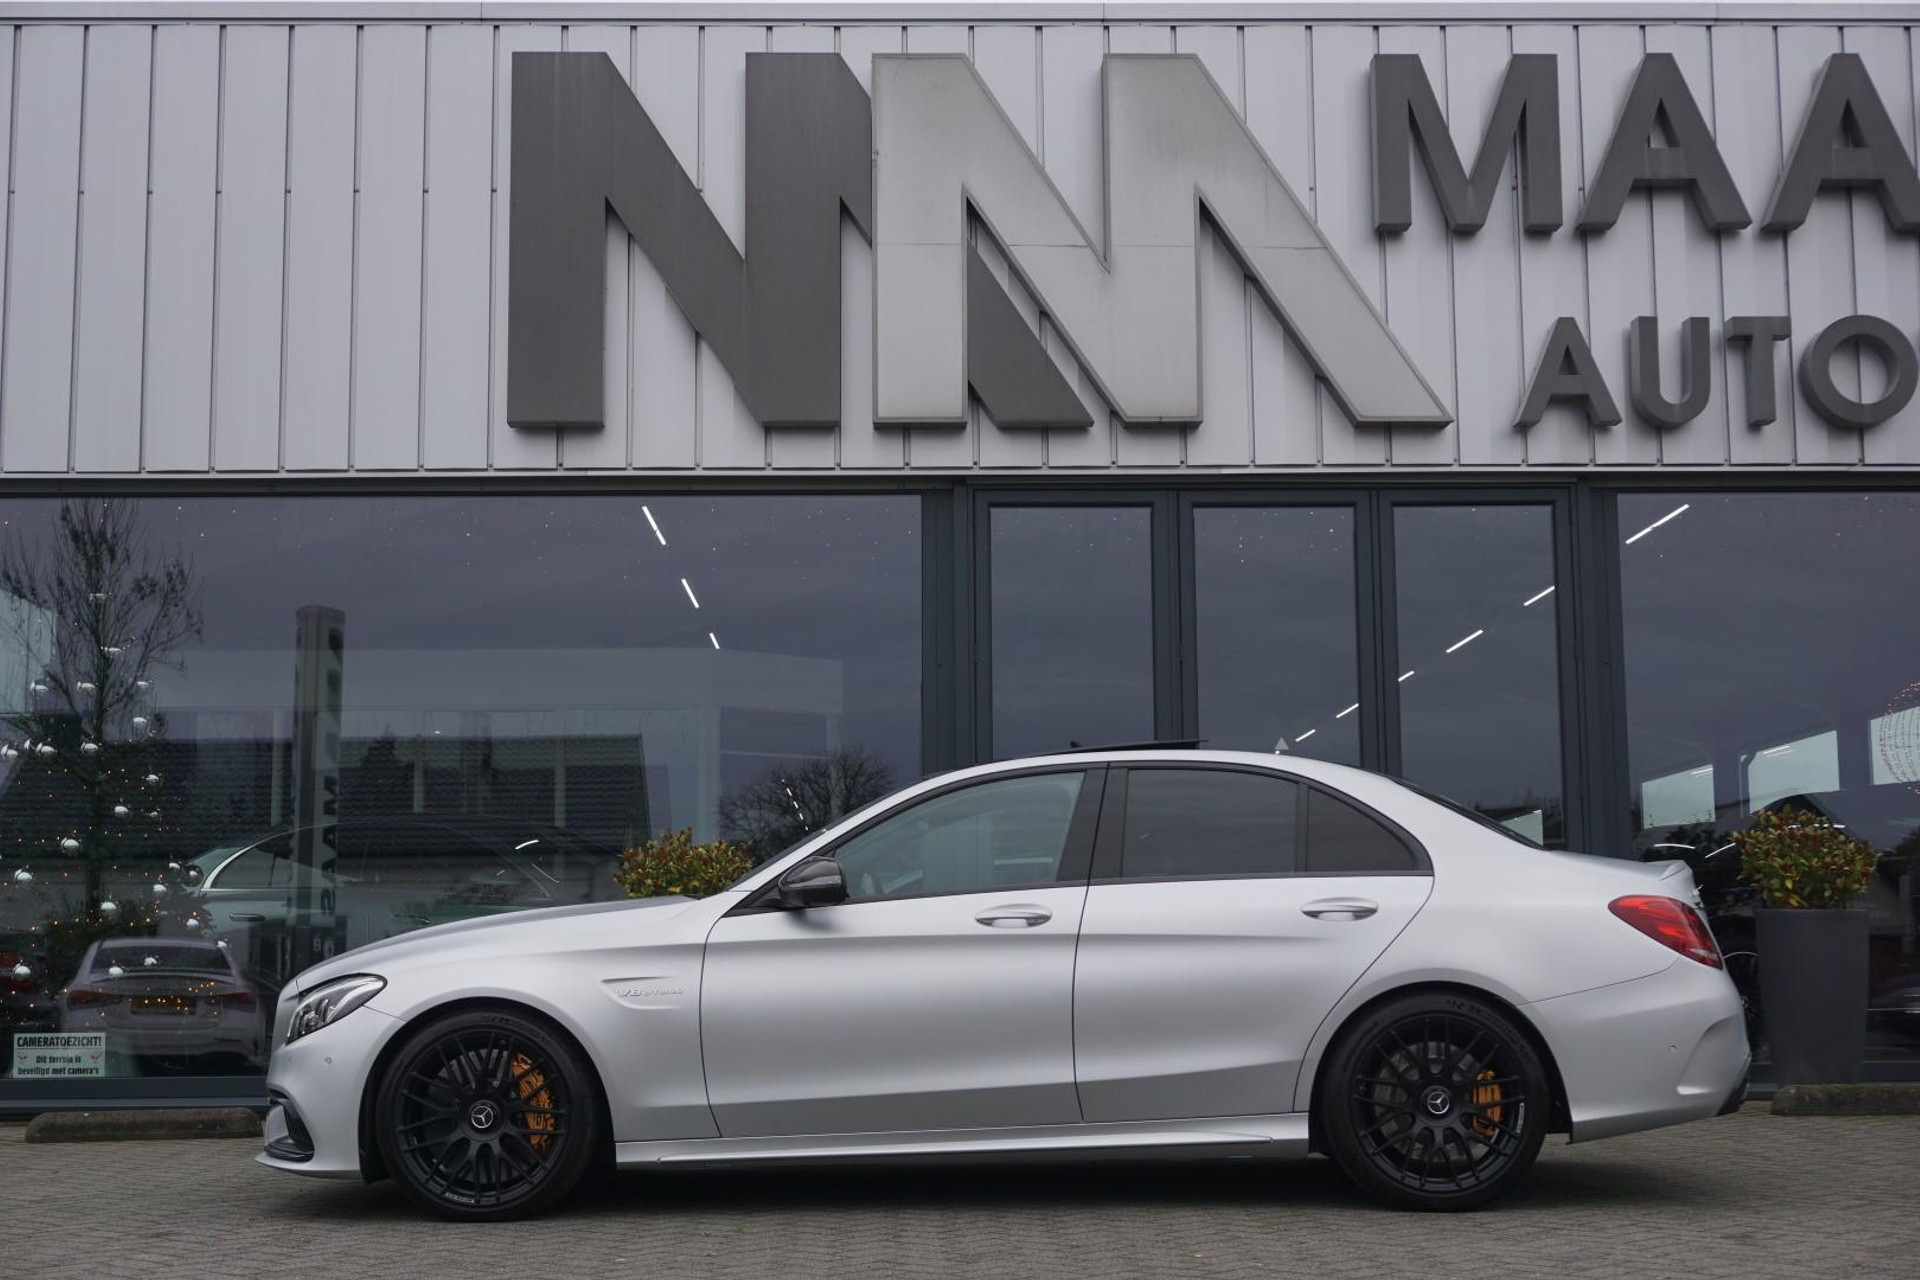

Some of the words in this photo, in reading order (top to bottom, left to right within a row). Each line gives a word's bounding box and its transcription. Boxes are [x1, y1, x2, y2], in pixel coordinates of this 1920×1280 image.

[1514, 314, 1919, 429] AUTO
[17, 1036, 102, 1047] CAMERATOEZICHT!
[51, 1067, 66, 1075] met
[67, 1066, 99, 1075] camera's
